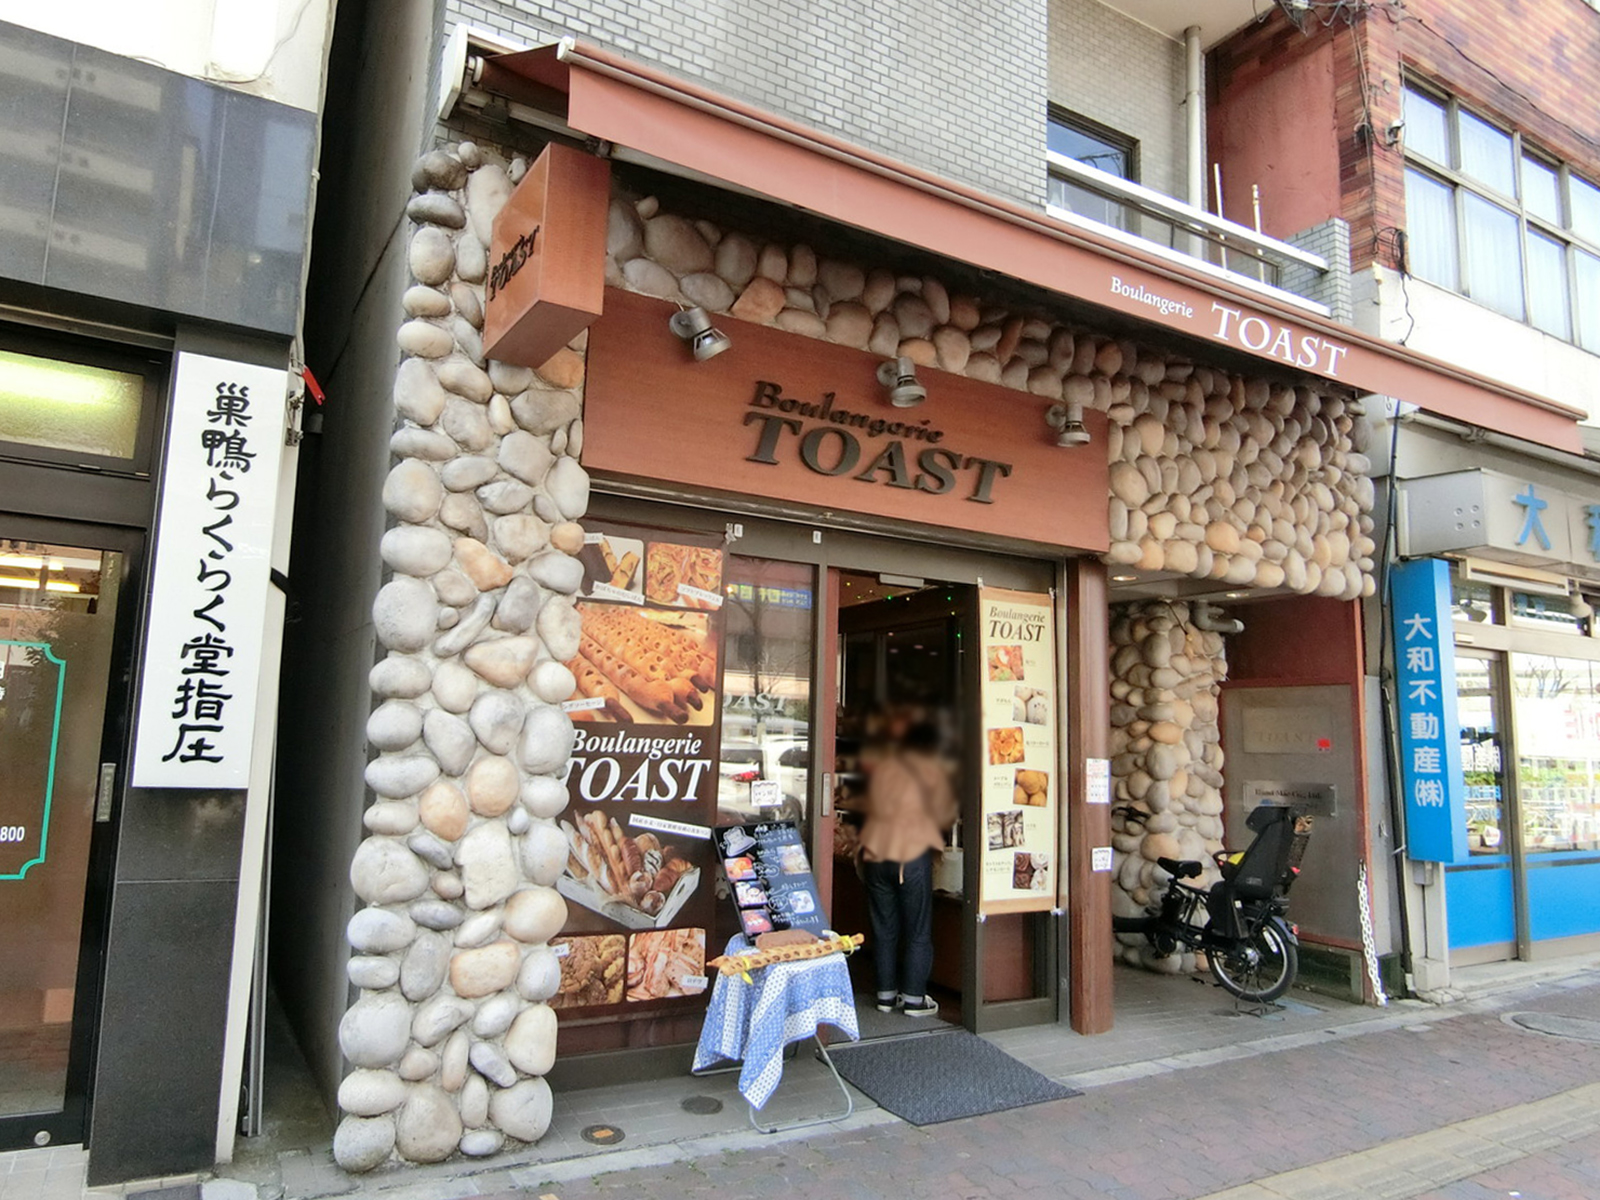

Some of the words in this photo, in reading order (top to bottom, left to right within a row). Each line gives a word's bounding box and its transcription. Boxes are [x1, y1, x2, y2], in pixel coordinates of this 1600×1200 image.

[1110, 276, 1193, 319] Boulangerie
[1211, 301, 1347, 377] TOAST
[747, 379, 944, 444] Boulangerie
[743, 411, 1013, 505] TOAST
[162, 381, 257, 763] 巣鴨らくらく堂指圧
[989, 606, 1046, 623] Boulangerie
[990, 620, 1046, 642] TOAST
[573, 728, 702, 760] Boulangerie
[564, 756, 712, 802] TOAST
